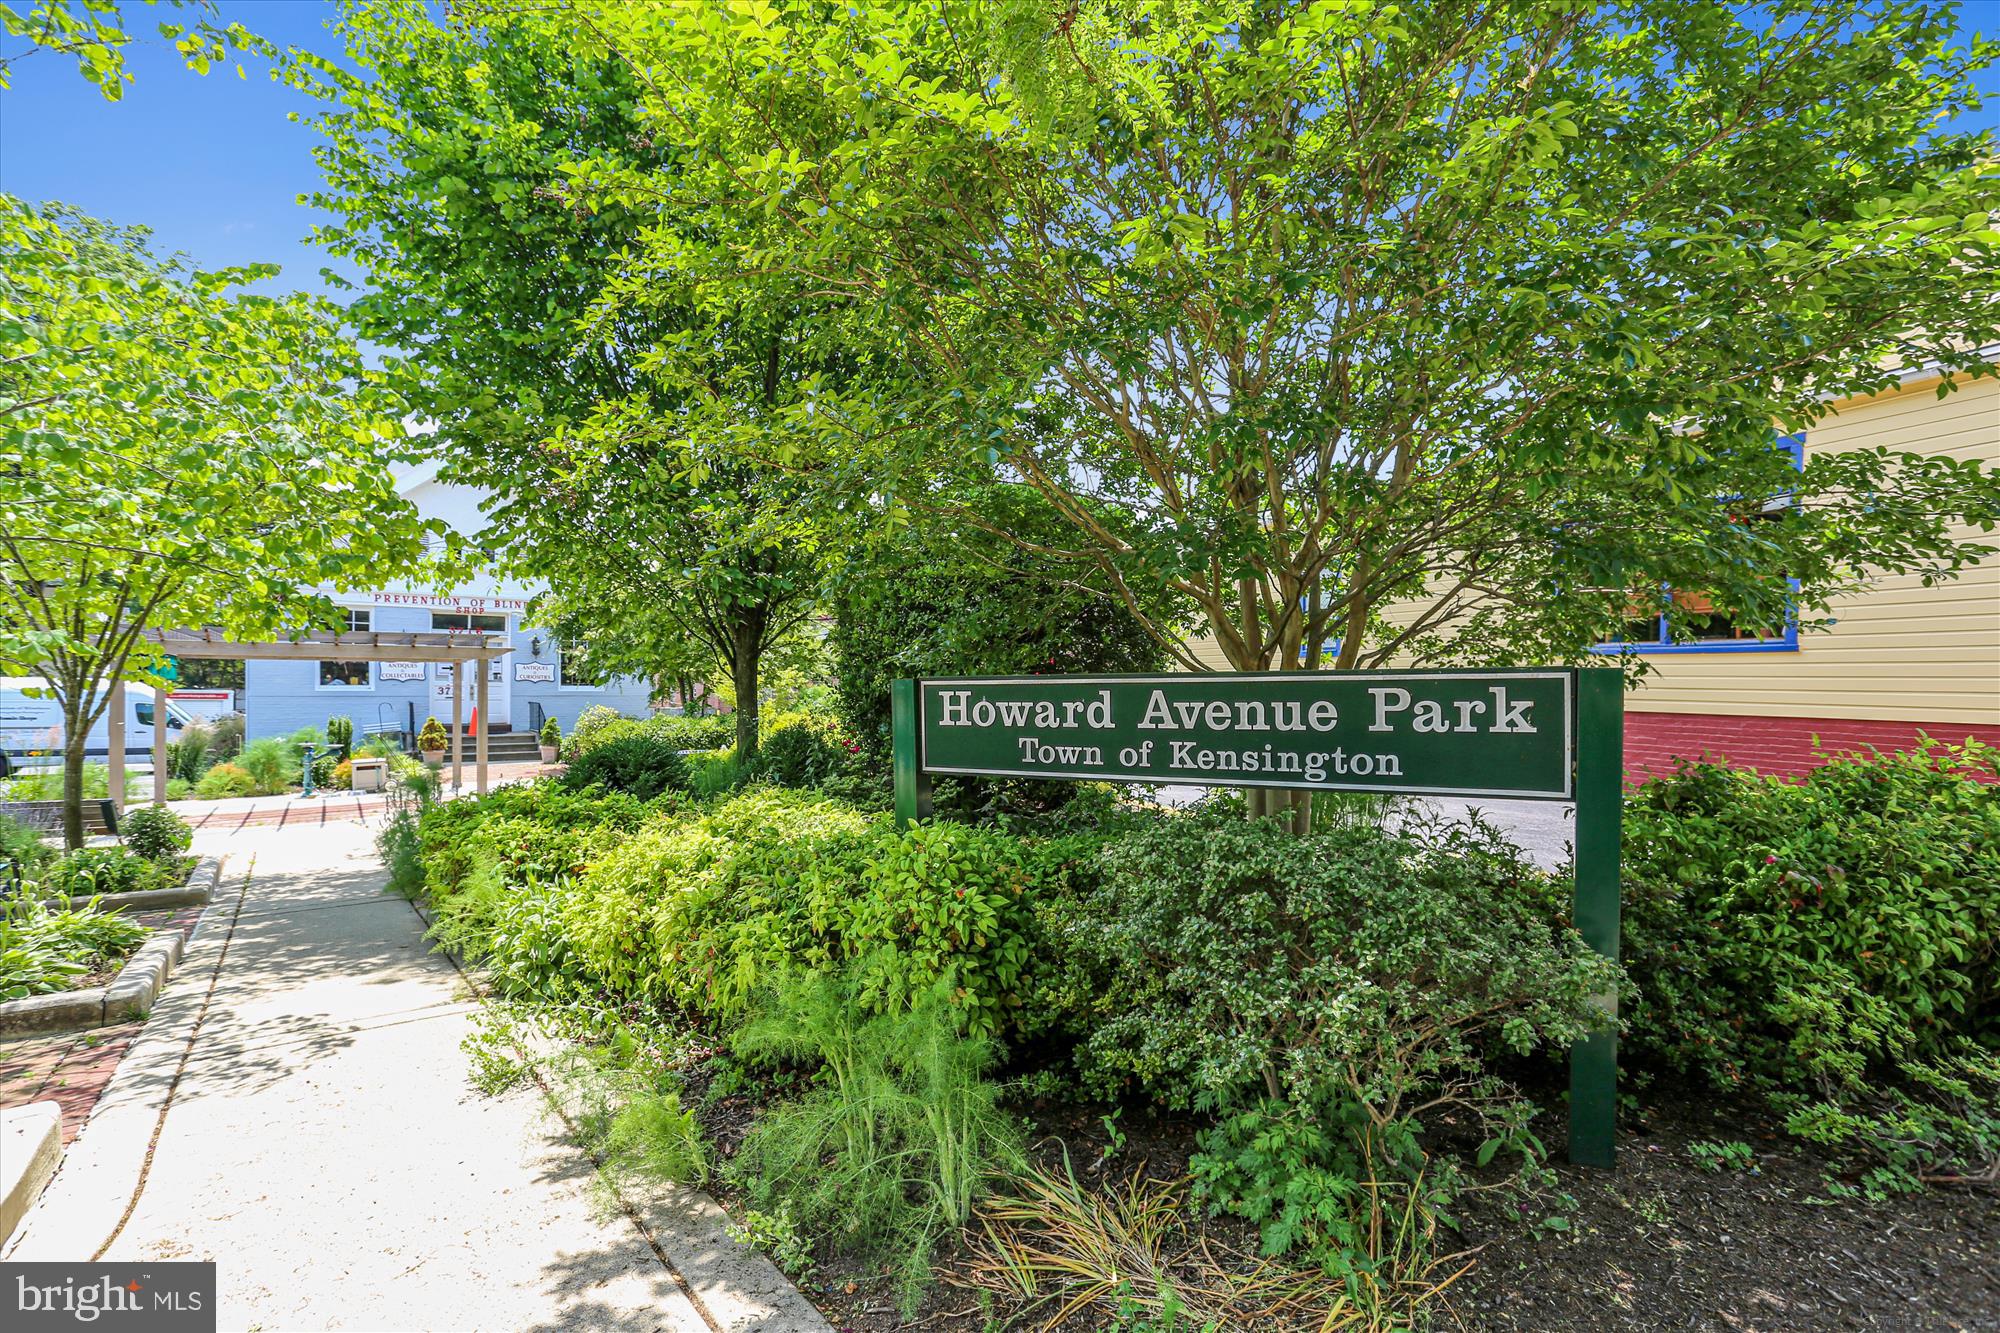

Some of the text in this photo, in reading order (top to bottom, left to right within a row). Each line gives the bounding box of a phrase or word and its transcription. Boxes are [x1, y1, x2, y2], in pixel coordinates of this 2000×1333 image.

[375, 594, 461, 606] PREVENTION
[470, 599, 486, 607] OF
[455, 606, 486, 615] SHOP
[938, 685, 1538, 734] Howard Avenue Park
[1018, 737, 1404, 782] Town of Kensington
